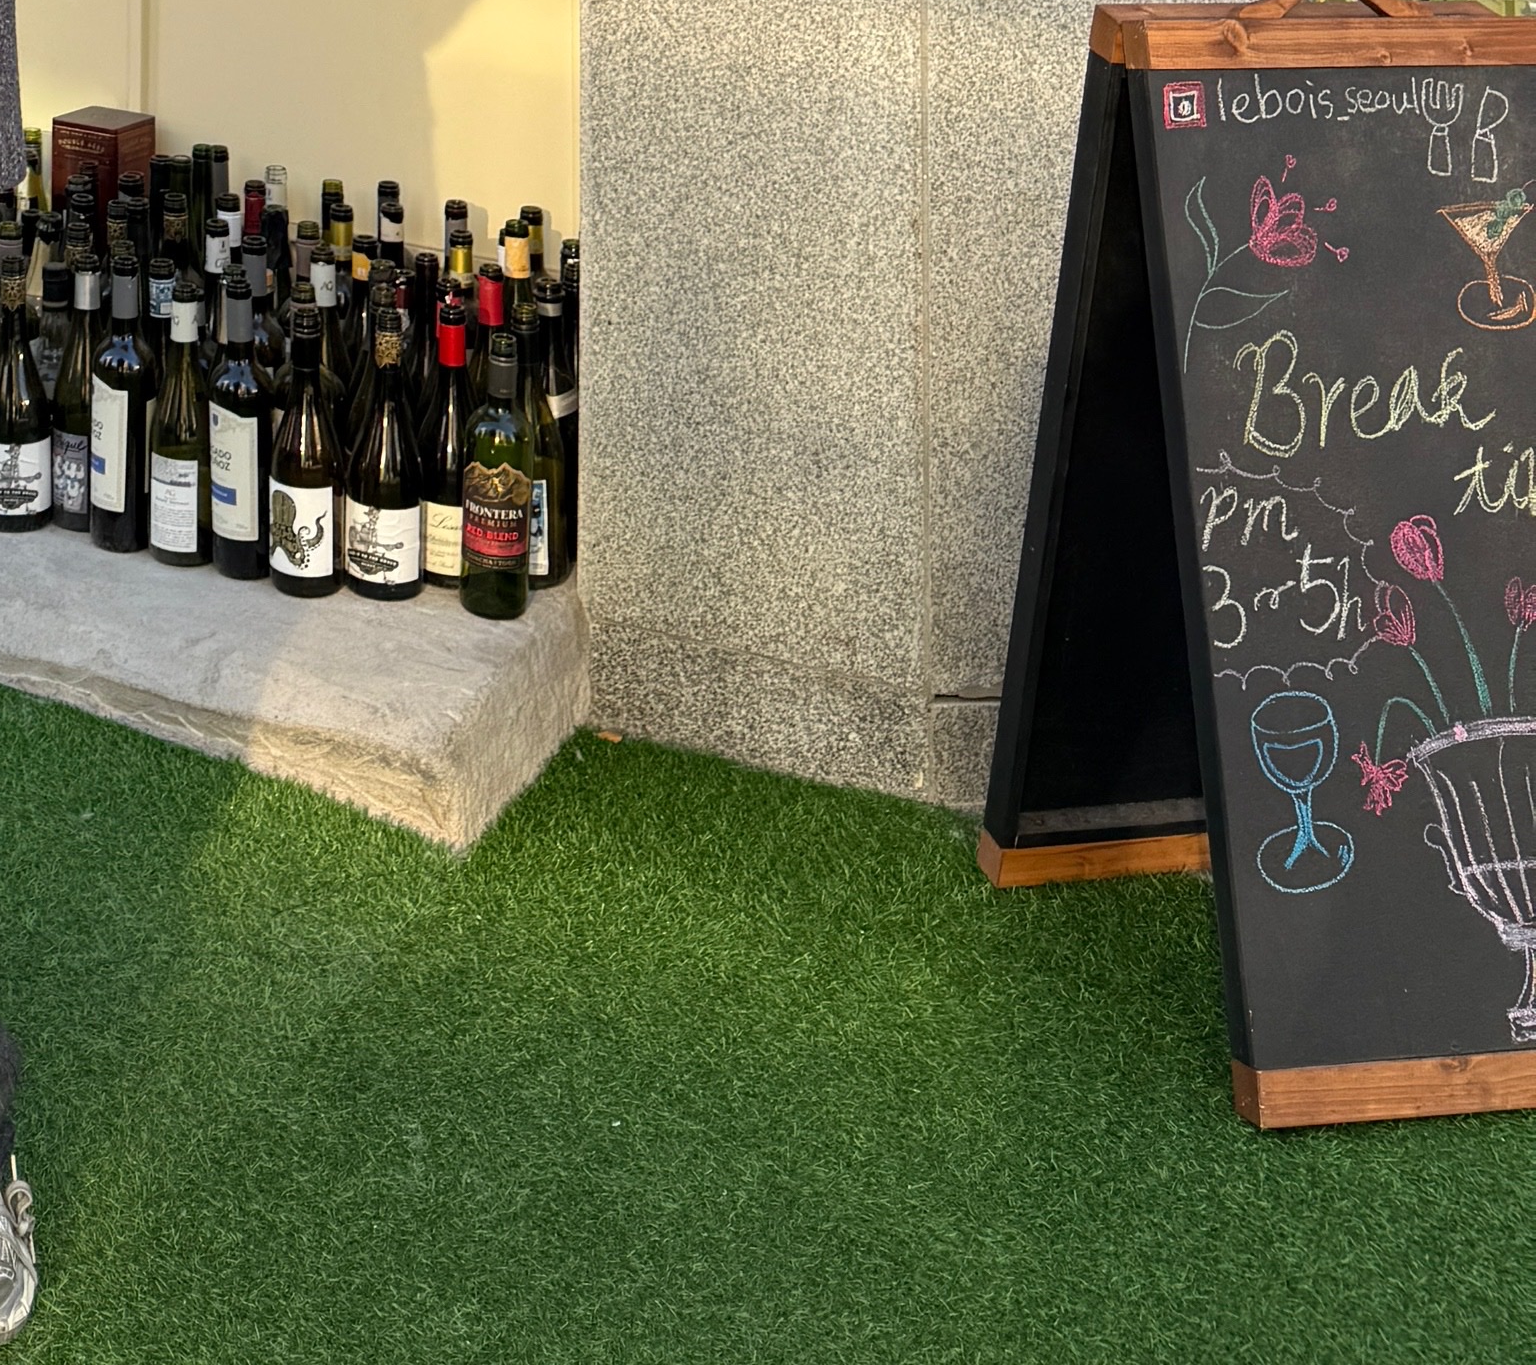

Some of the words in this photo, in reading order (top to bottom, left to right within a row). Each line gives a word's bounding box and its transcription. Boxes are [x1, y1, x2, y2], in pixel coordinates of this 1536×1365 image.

[1217, 73, 1420, 124] lebois_seoul
[1233, 329, 1496, 458] Break
[465, 498, 524, 520] FRONTERA
[1200, 485, 1300, 552] pm
[486, 530, 519, 541] BLEND
